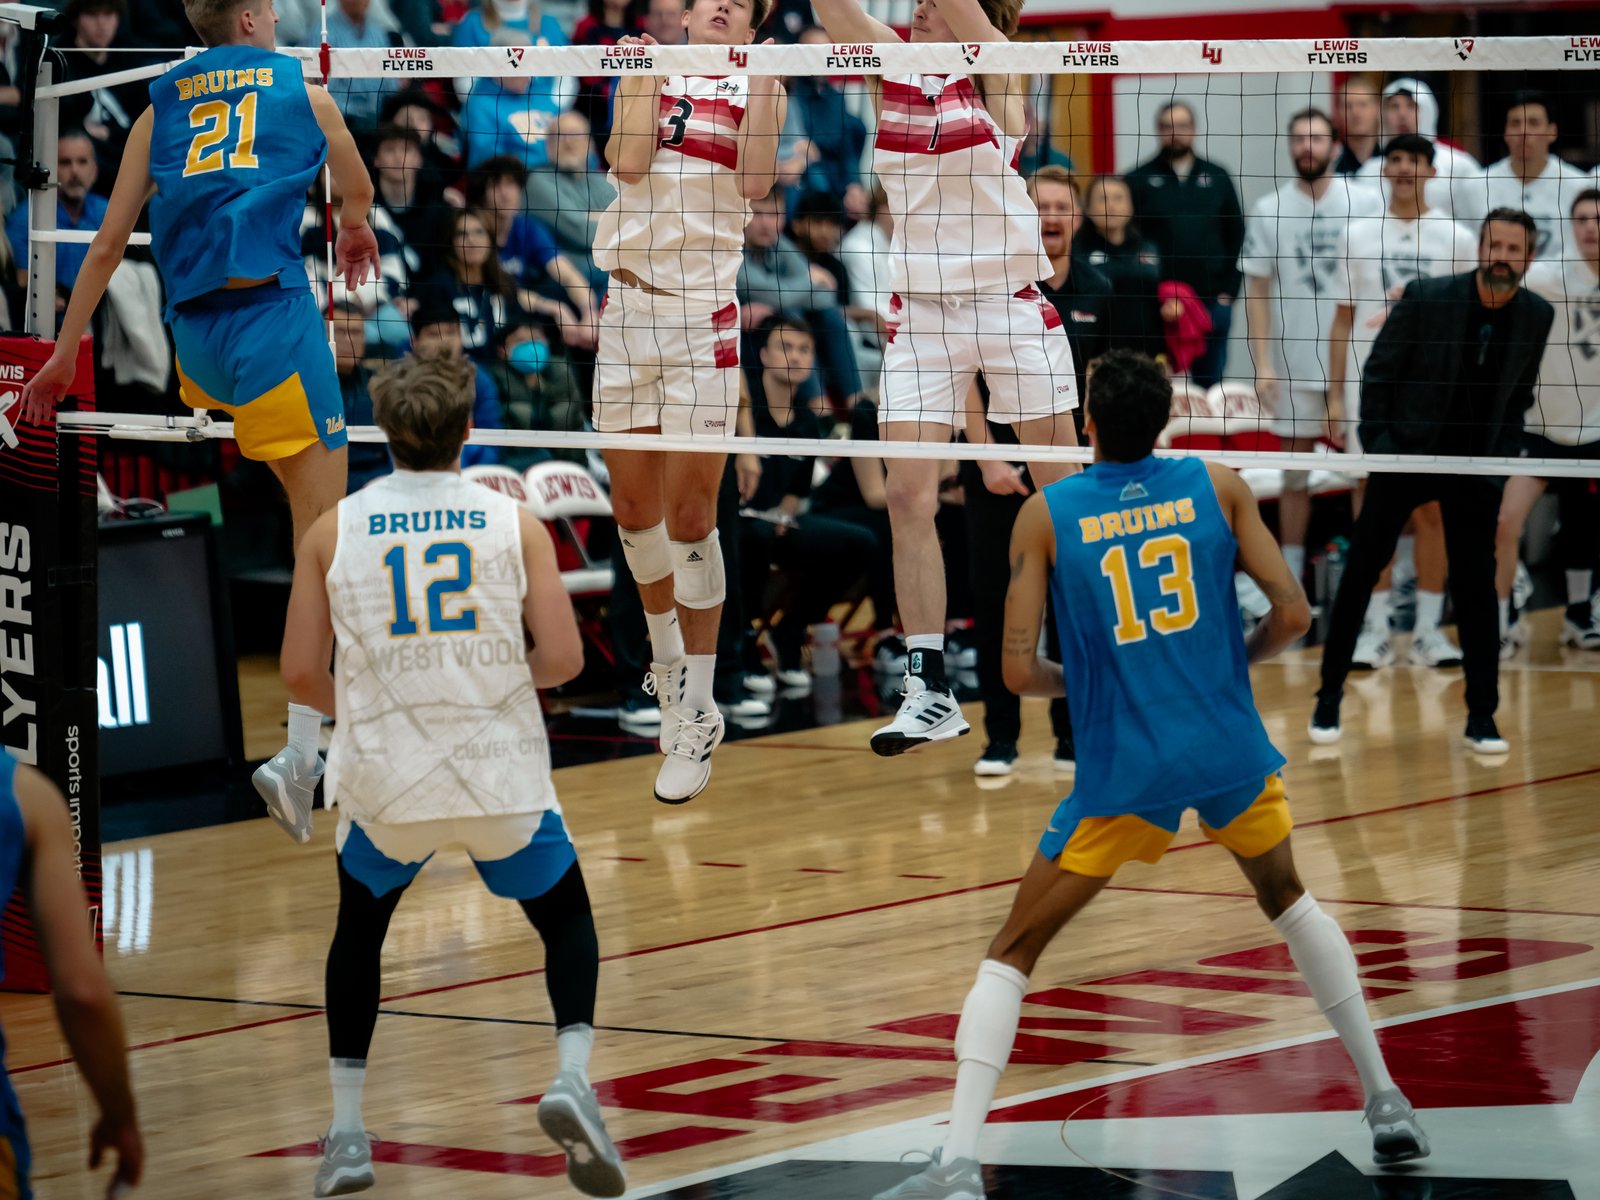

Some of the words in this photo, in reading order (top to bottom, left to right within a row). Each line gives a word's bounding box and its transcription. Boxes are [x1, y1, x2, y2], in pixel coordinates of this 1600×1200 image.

[605, 46, 645, 57] LEWIS
[832, 45, 873, 55] LEWIS
[1068, 42, 1112, 53] LEWIS
[1314, 40, 1358, 51] LEWIS
[388, 49, 426, 59] LEWIS
[1062, 54, 1119, 67] FLYERS
[1307, 52, 1367, 64] FLYERS
[382, 59, 433, 71] FLYERS
[601, 57, 652, 70] FLYERS
[826, 55, 881, 68] FLYERS
[175, 67, 274, 101] BRUINS
[660, 97, 694, 148] 3
[182, 90, 260, 179] 21
[535, 473, 597, 504] LEWIS
[368, 509, 487, 536] BRUINS
[1078, 497, 1197, 544] BRUINS
[382, 540, 481, 640] 12
[1100, 533, 1200, 646] 13
[65, 725, 82, 794] sports
